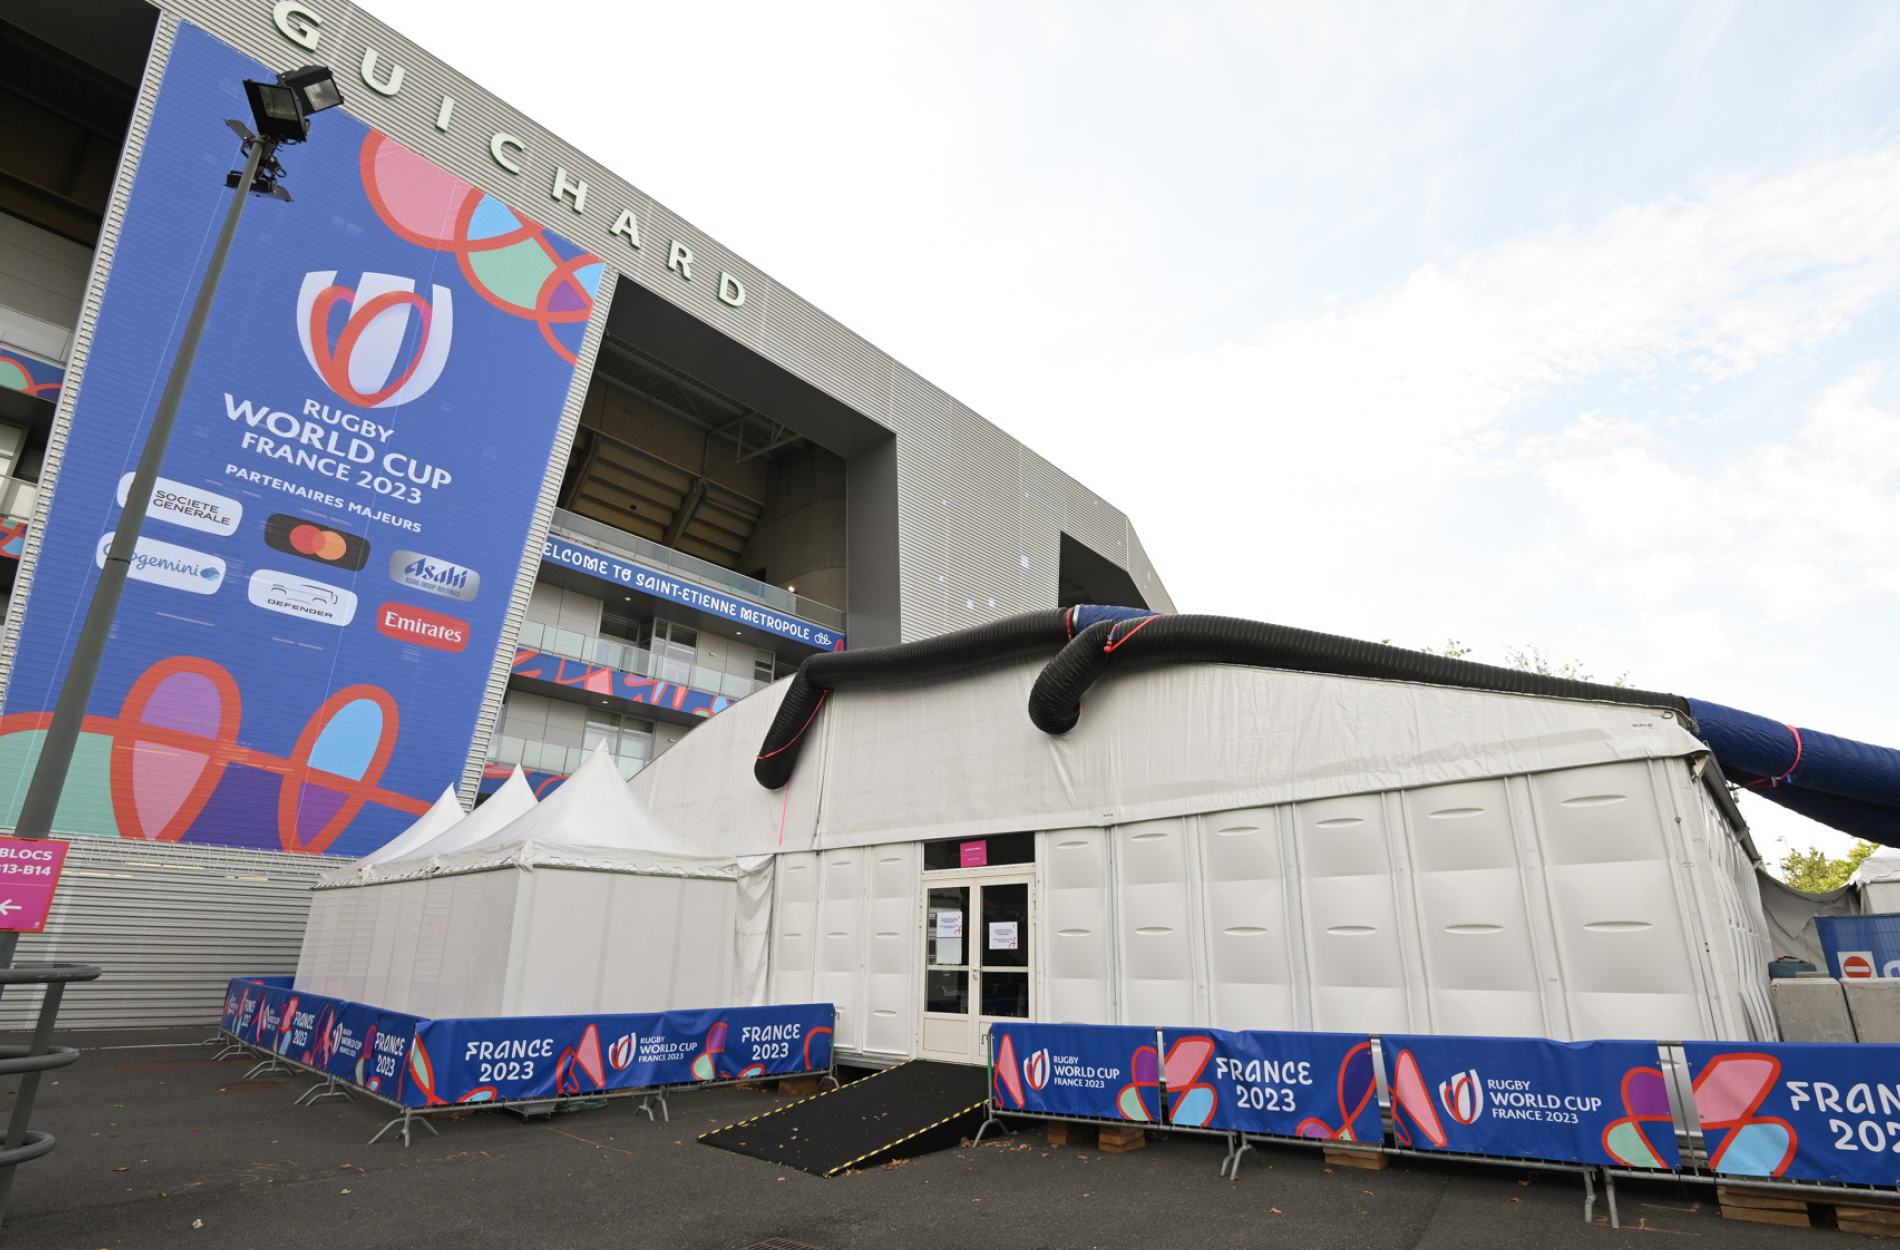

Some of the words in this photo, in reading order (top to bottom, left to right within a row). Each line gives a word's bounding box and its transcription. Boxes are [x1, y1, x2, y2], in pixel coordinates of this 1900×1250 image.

[272, 0, 746, 308] GUICHARD
[303, 398, 395, 443] RUGBY
[224, 392, 376, 464] WORLD
[382, 453, 452, 490] CUP
[241, 431, 351, 482] FRANCE
[356, 470, 423, 505] 2023
[155, 490, 219, 514] SOCIETE
[225, 464, 344, 509] PARTENAIRES
[348, 502, 422, 533] MAJEURS
[153, 499, 231, 526] GENERALE
[404, 558, 468, 589] Asahi
[267, 598, 333, 619] DEFENDER
[613, 564, 632, 582] TO
[636, 574, 737, 616] SAINT-ETIENNE
[740, 607, 810, 640] METROPOLE
[385, 611, 462, 643] Emirates
[0, 848, 53, 861] BLOCS
[0, 863, 51, 876] 13-B14
[374, 1032, 406, 1057] FRANCE
[640, 1035, 665, 1044] RUGBY
[742, 1023, 801, 1044] FRANCE
[465, 1038, 554, 1062] FRANCE
[638, 1054, 666, 1063] FRANCE
[667, 1052, 684, 1061] 2023
[640, 1044, 675, 1055] WORLD
[677, 1042, 698, 1052] CUP
[752, 1043, 789, 1061] 2023
[376, 1054, 395, 1077] 2023
[1053, 1055, 1079, 1065] RUGBY
[478, 1061, 534, 1082] 2023
[1054, 1065, 1096, 1078] WORLD
[1097, 1067, 1120, 1080] CUP
[1216, 1057, 1313, 1086] FRANCE
[1054, 1077, 1083, 1087] FRANCE
[1084, 1079, 1105, 1089] 2023
[1487, 1079, 1531, 1091] RUGBY
[1237, 1085, 1296, 1112] 2023
[1489, 1091, 1560, 1110] WORLD
[1564, 1094, 1602, 1112] CUP
[1491, 1108, 1542, 1121] FRANCE
[1544, 1111, 1579, 1124] 2023
